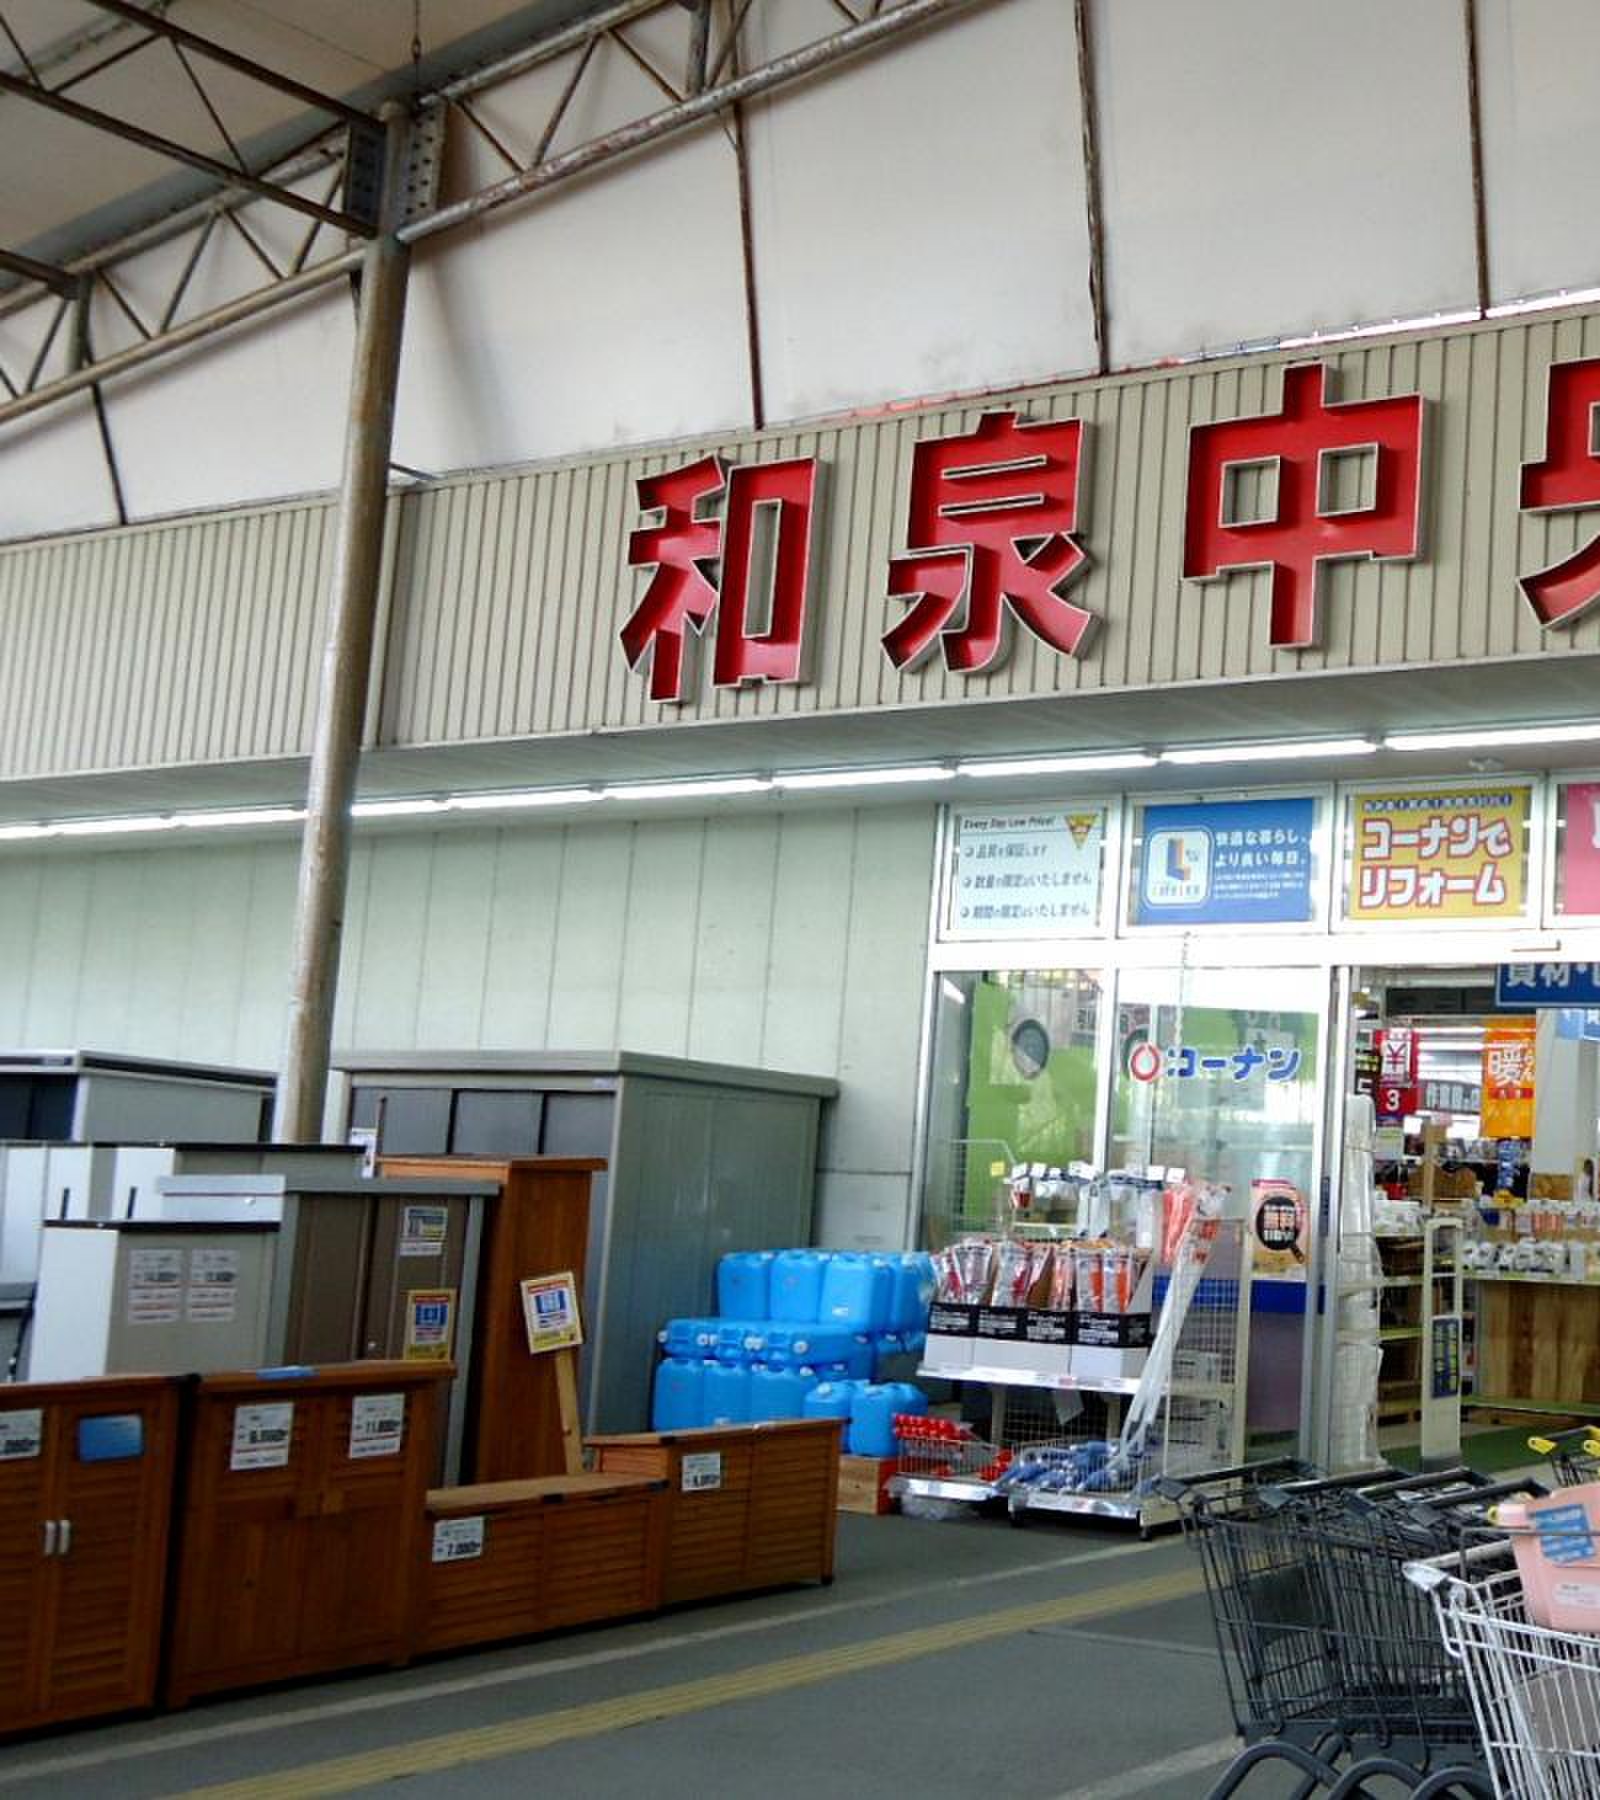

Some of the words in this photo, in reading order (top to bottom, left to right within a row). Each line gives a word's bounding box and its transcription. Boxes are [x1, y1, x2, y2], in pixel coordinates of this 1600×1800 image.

[1363, 814, 1514, 861] コーナンで
[1361, 863, 1506, 909] リフォーム
[1166, 1047, 1299, 1081] コーナン
[1385, 1088, 1400, 1112] 3
